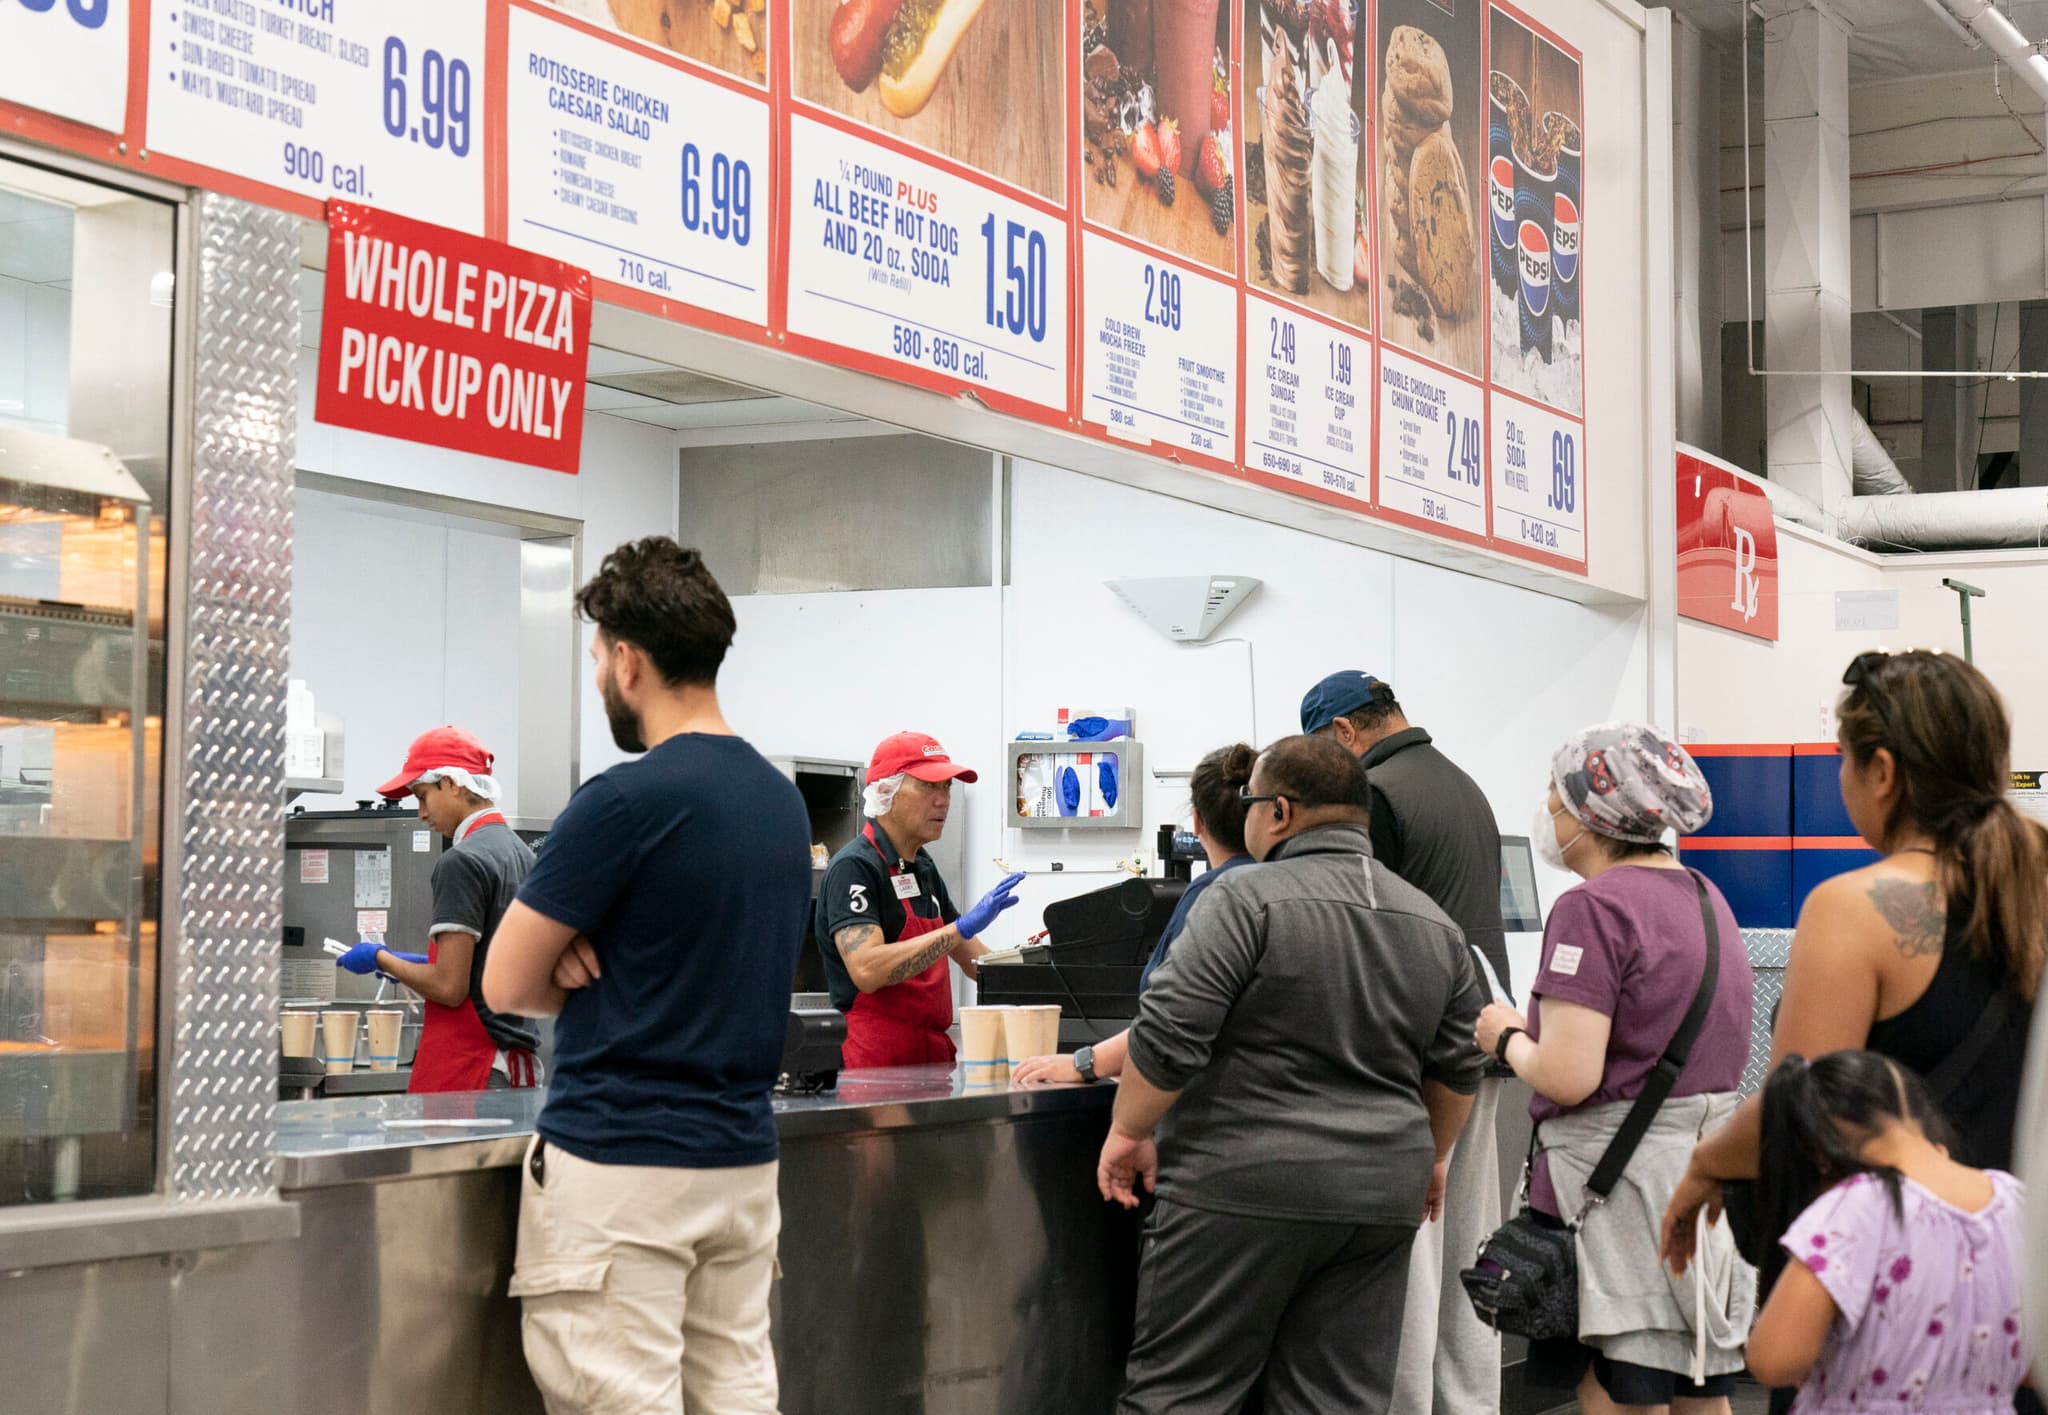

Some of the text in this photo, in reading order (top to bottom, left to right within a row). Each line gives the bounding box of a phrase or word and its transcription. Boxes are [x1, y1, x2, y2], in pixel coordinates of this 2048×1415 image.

[384, 35, 471, 157] 6.99
[529, 53, 669, 123] ROTISSERIE CHICKEN
[549, 87, 650, 141] CAESAR SALAD
[284, 142, 373, 199] 900 cal.
[681, 142, 751, 246] 6.99
[854, 164, 893, 197] POUND
[897, 181, 937, 214] PLUS
[813, 178, 959, 256] ALL BEEF HOT DOG
[823, 218, 857, 256] AND
[863, 233, 883, 265] 20
[911, 247, 950, 288] SODA
[1553, 227, 1578, 250] EPSI
[619, 258, 672, 292] 710 cal.
[981, 212, 1047, 343] 1.50
[1519, 246, 1550, 280] PEPSI
[344, 230, 573, 354] WHOLE PIZZA
[1144, 264, 1181, 331] 2.99
[1099, 330, 1146, 358] MOCHA FREEZE
[1105, 317, 1141, 340] COLD BREW
[1270, 317, 1296, 366] 2.49
[893, 325, 921, 360] 580
[933, 337, 959, 372] 850
[963, 351, 989, 381] cal.
[1329, 339, 1352, 386] 1.99
[338, 327, 572, 440] PICK UP ONLY
[1178, 357, 1195, 375] FRUIT
[1196, 363, 1225, 384] SMOOTHIE
[1266, 364, 1300, 388] ICE CREAM
[1383, 366, 1447, 407] DOUBLE CHOCOLATE
[1271, 383, 1296, 404] SUNDAE
[1325, 384, 1355, 409] ICE CREAM
[1392, 390, 1439, 423] CHUNK COOKIE
[1124, 414, 1136, 427] cal.
[1335, 405, 1346, 420] CUP
[1191, 432, 1213, 450] 230 cal.
[1506, 420, 1516, 441] 20
[1447, 410, 1481, 487] 2.49
[1506, 444, 1526, 470] SODA
[1292, 462, 1303, 476] cal.
[1347, 479, 1357, 493] cal.
[1548, 430, 1575, 514] .69
[1422, 497, 1449, 521] 750 cal.
[1545, 528, 1558, 549] cal.
[849, 884, 869, 913] 3
